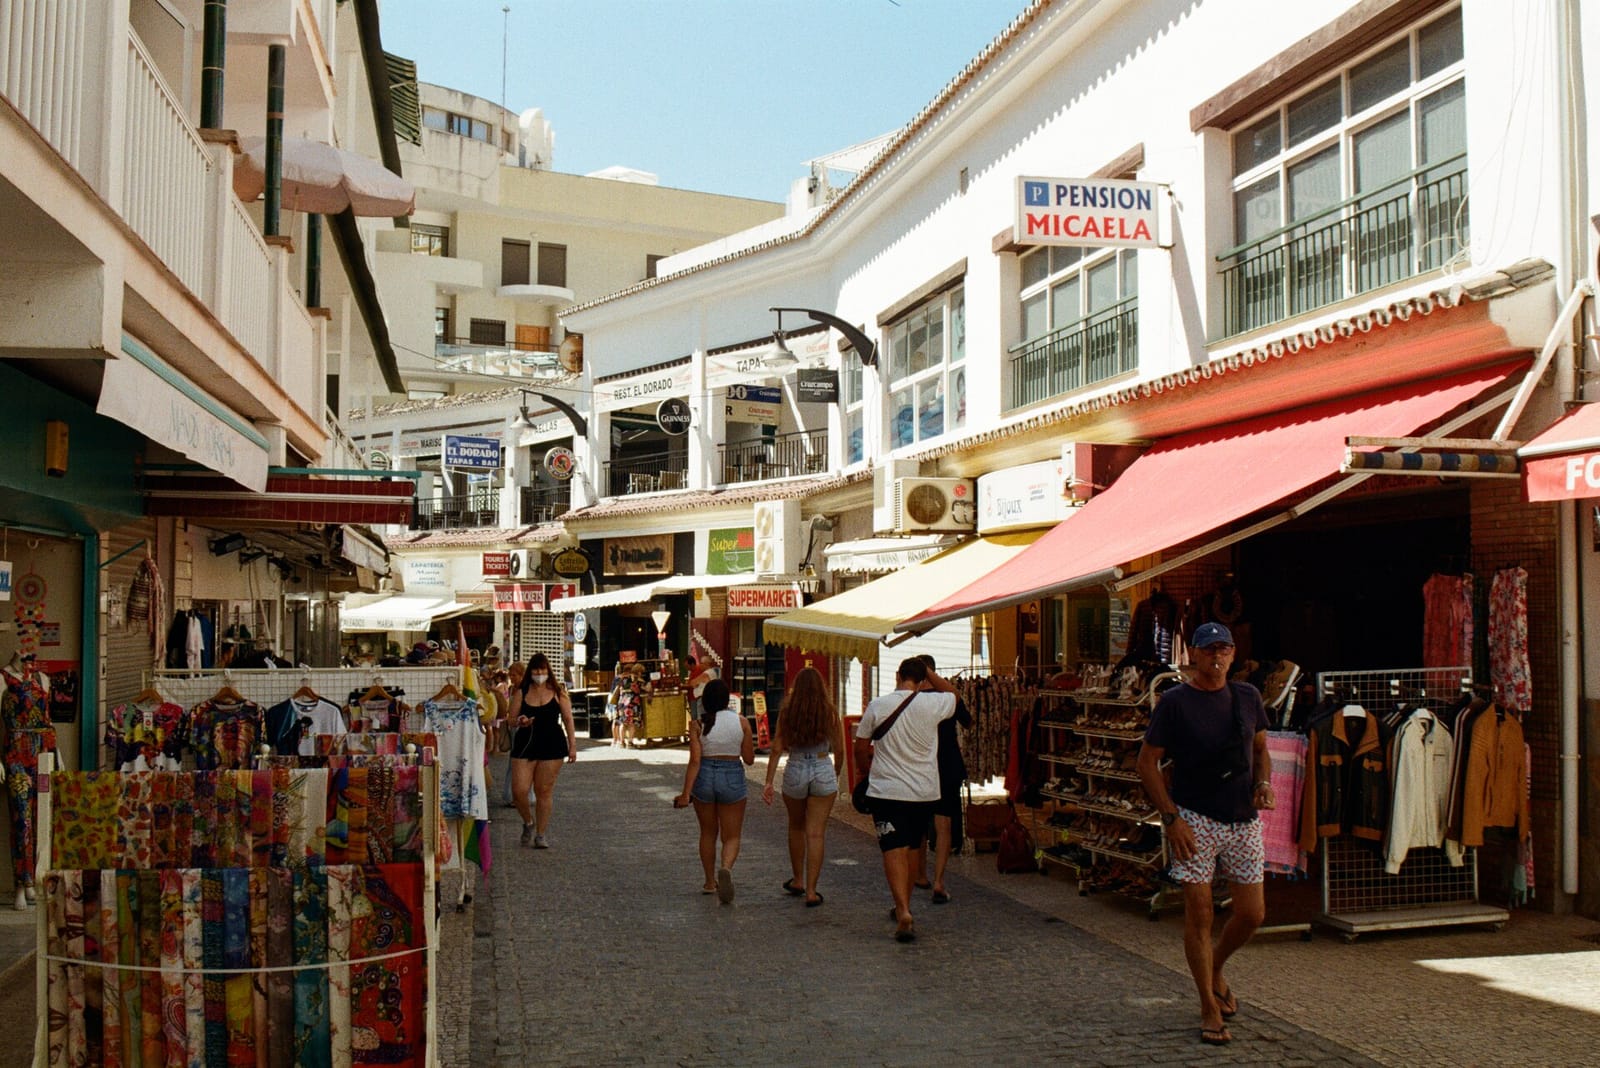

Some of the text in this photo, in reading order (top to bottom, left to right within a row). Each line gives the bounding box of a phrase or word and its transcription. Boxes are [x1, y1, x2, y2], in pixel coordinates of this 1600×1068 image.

[1055, 184, 1152, 211] PENSION
[1026, 212, 1153, 241] MICAELA
[633, 385, 642, 396] EL
[643, 377, 673, 395] DORADO
[660, 414, 690, 423] GUINNESS
[446, 446, 499, 459] EL DORADO
[447, 457, 474, 465] TAPAS
[481, 459, 498, 467] BAR
[495, 591, 513, 602] TOURS
[521, 590, 543, 602] TICKETS
[728, 588, 798, 608] SUPERMARKET
